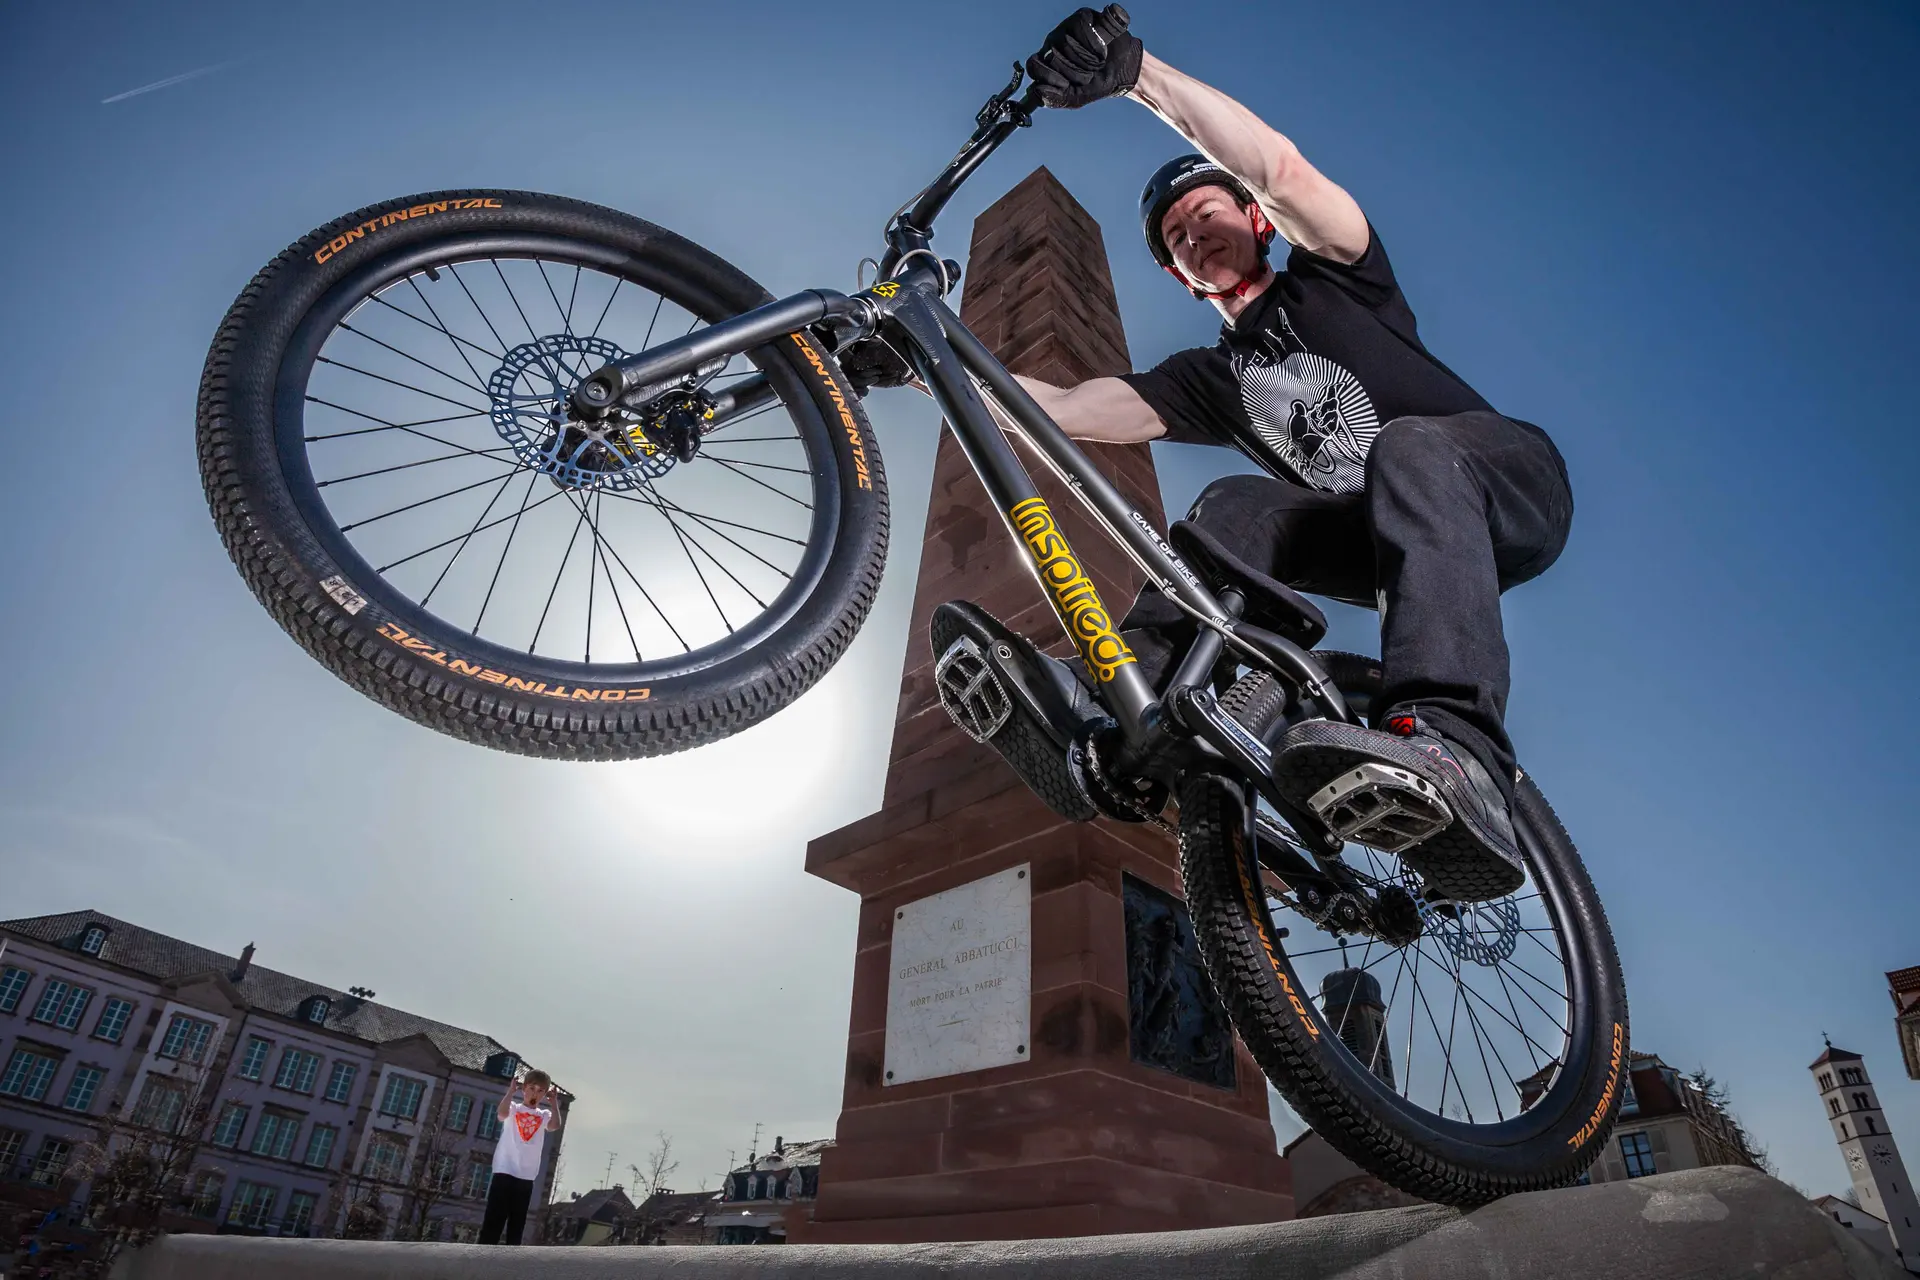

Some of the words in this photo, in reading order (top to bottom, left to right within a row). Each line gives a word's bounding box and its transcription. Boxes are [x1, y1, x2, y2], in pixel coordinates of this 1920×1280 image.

[314, 199, 502, 265] CONTINENTAL
[790, 333, 872, 491] CONTINENTAL
[1132, 511, 1162, 543] GAME
[1159, 542, 1177, 558] OF
[1173, 559, 1199, 586] BIKE
[375, 622, 651, 703] CONTINENTAL
[950, 919, 964, 933] AU
[908, 995, 931, 1008] MORT
[934, 990, 955, 1001] POUR
[959, 986, 970, 996] LA
[974, 977, 1003, 992] PATRIE
[1567, 1022, 1625, 1151] CONTINENTAL
